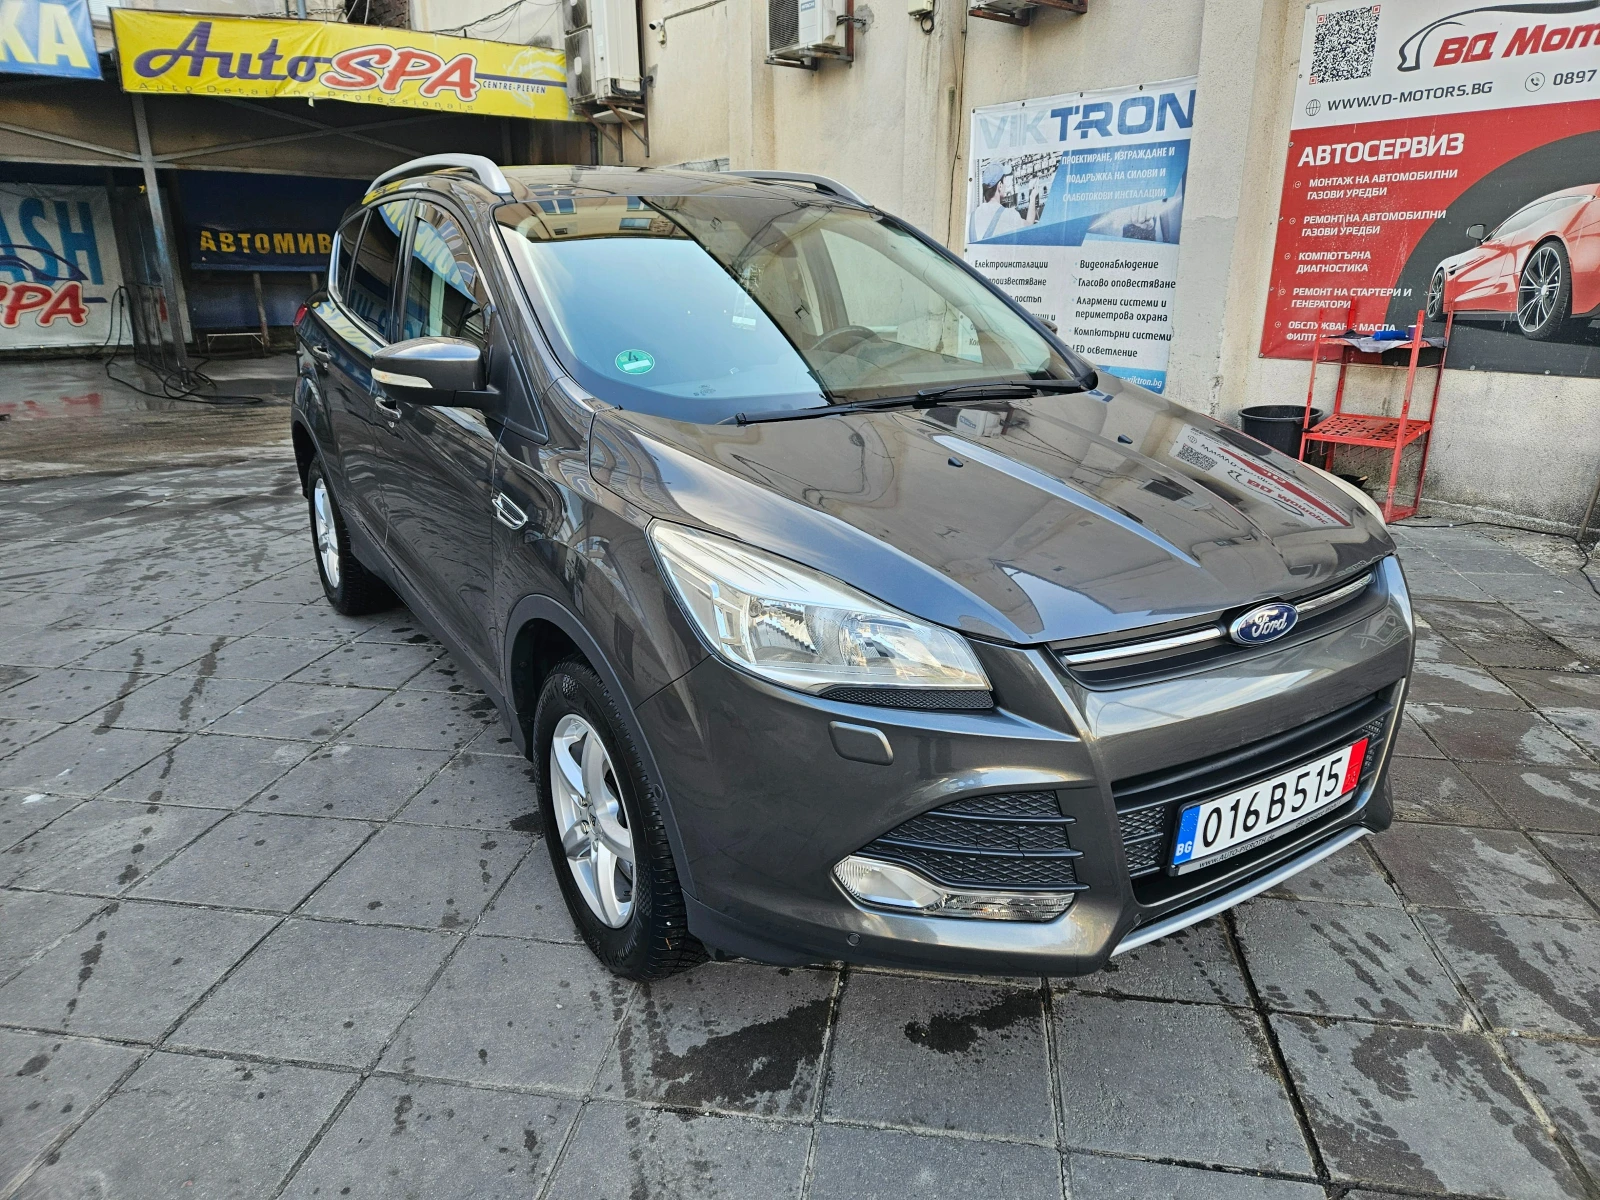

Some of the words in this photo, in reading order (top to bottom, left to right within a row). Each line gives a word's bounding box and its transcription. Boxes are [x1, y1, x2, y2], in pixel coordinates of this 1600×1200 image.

[134, 21, 318, 82] Auto
[321, 45, 480, 101] SPA
[1553, 69, 1597, 86] 0897
[482, 80, 547, 94] CENTRE-PLEVEN
[1327, 82, 1493, 111] WWW.VD-MOTORS.BG
[1061, 153, 1113, 165] ПРОЕКТИРАНЕ,
[1114, 147, 1168, 160] ИЗГРАЖДАНЕ
[1168, 146, 1176, 156] И
[1297, 133, 1465, 167] АВТОСЕРВИЗ
[1114, 171, 1125, 180] НА
[1126, 168, 1159, 179] СИЛОВИ
[1309, 176, 1355, 187] МОНТАЖ
[1355, 175, 1370, 185] НА
[1371, 169, 1458, 183] АВТОМОБИЛНИ
[1114, 188, 1166, 200] ИНСТАЛАЦИИ
[1307, 190, 1344, 200] ГАЗОВИ
[1346, 187, 1387, 198] УРЕДБИ
[1303, 215, 1345, 224] РЕМОНТ
[1345, 214, 1360, 223] НА
[1361, 209, 1447, 222] АВТОМОБИЛНИ
[1302, 227, 1338, 237] ГАЗОВИ
[1339, 225, 1381, 235] УРЕДБИ
[1298, 251, 1371, 260] КОМПЮТЪРНА
[974, 260, 1049, 270] Електроинсталации
[1080, 259, 1159, 271] Видеонаблюдение
[1296, 263, 1369, 274] ДИАГНОСТИКА
[1078, 278, 1109, 287] Гласово
[1110, 278, 1176, 289] оповестяване
[1293, 287, 1331, 296] РЕМОНТ
[1333, 287, 1348, 296] НА
[1350, 288, 1401, 297] СТАРТЕРИ
[1403, 288, 1412, 297] И
[0, 281, 88, 327] PA
[1076, 296, 1118, 307] Алармени
[1119, 298, 1159, 308] системи
[1161, 300, 1167, 308] и
[1291, 300, 1351, 309] ГЕНЕРАТОРИ
[1075, 310, 1134, 321] периметрова
[1136, 313, 1168, 323] охрана
[1074, 326, 1130, 340] Компютърни
[1132, 331, 1172, 341] системи
[1087, 345, 1138, 357] осветление
[1252, 609, 1287, 637] Ford
[1175, 840, 1193, 857] BG
